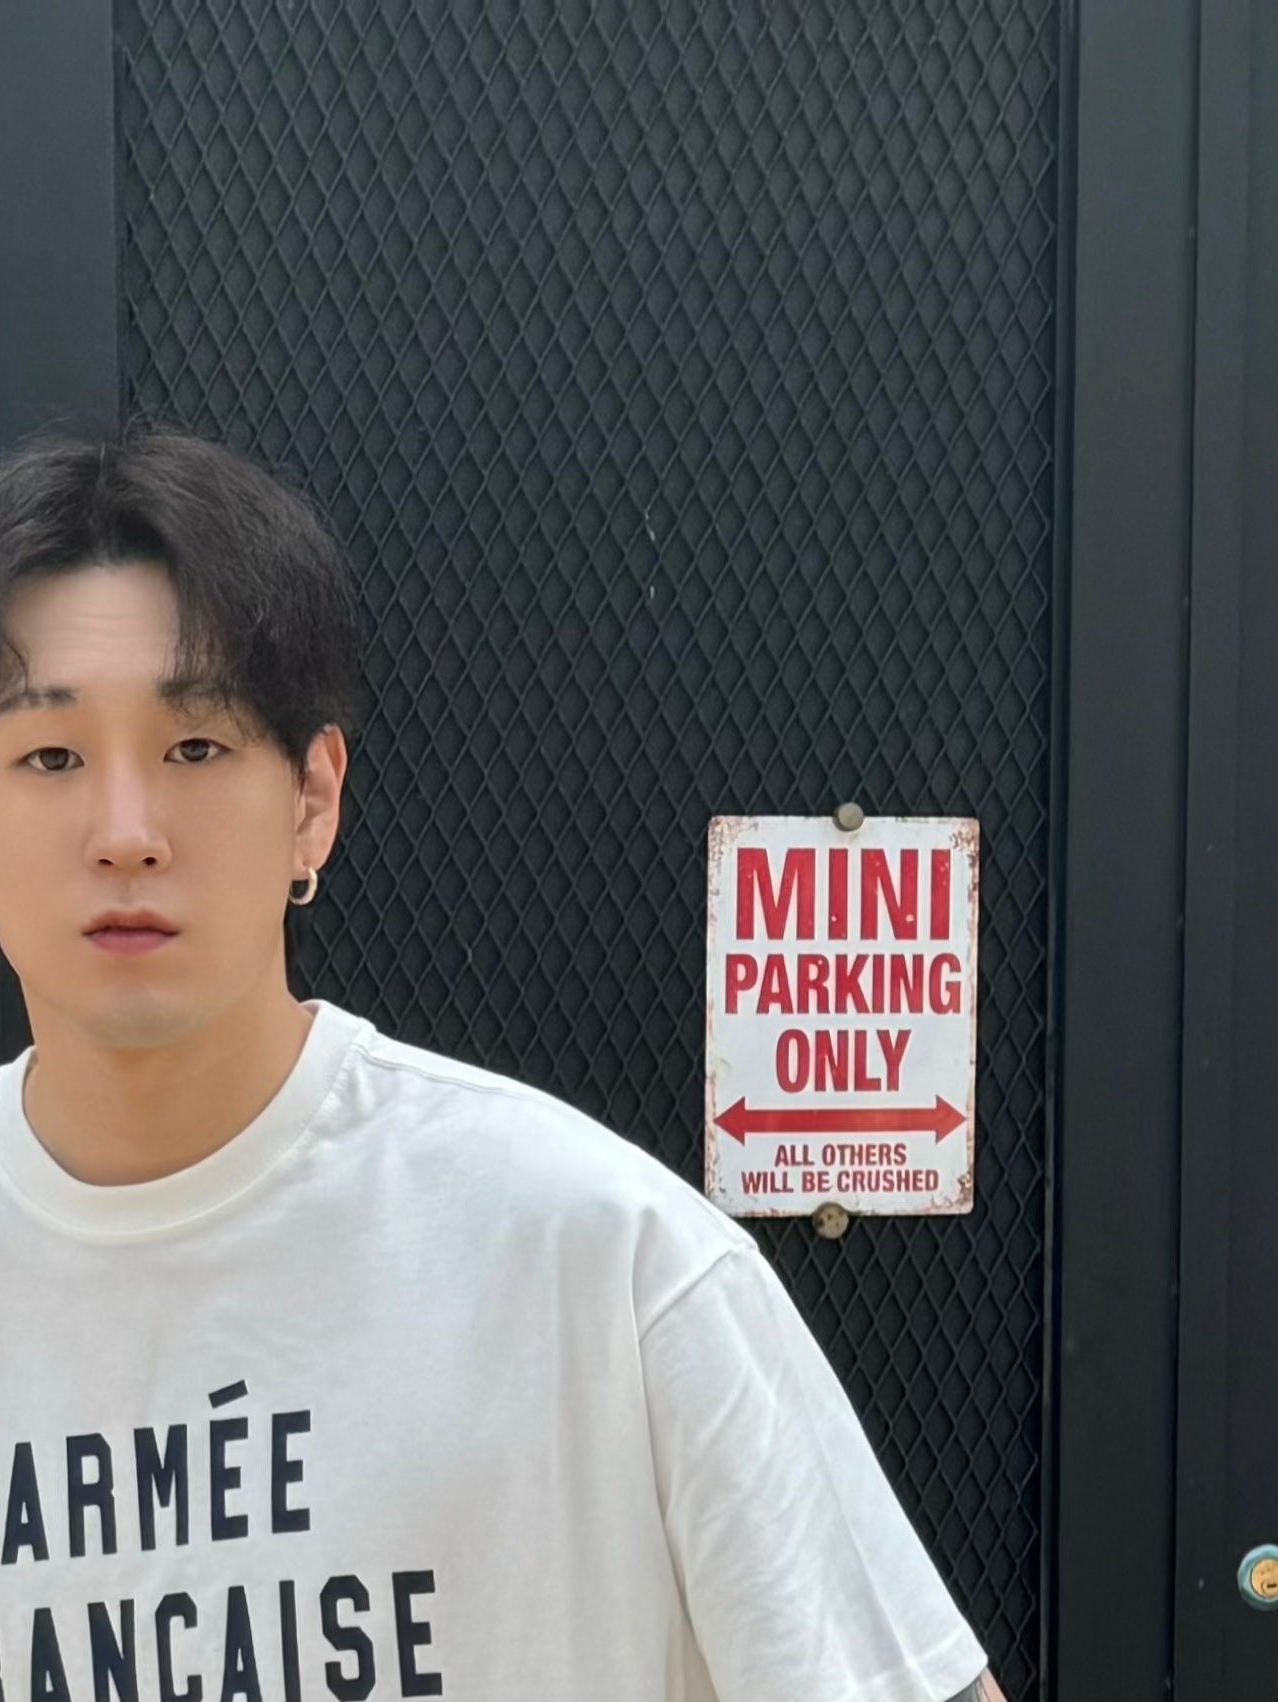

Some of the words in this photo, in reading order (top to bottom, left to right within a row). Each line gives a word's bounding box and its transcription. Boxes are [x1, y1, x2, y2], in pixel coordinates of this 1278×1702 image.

[736, 848, 950, 941] MINI
[725, 953, 962, 1015] PARKING
[775, 1028, 912, 1093] ONLY
[741, 1171, 794, 1194] WILL
[802, 1170, 830, 1193] BE
[837, 1169, 940, 1193] CRUSHED
[774, 1144, 815, 1166] ALL
[821, 1143, 907, 1166] OTHERS
[1, 1380, 311, 1566] ARMÉE
